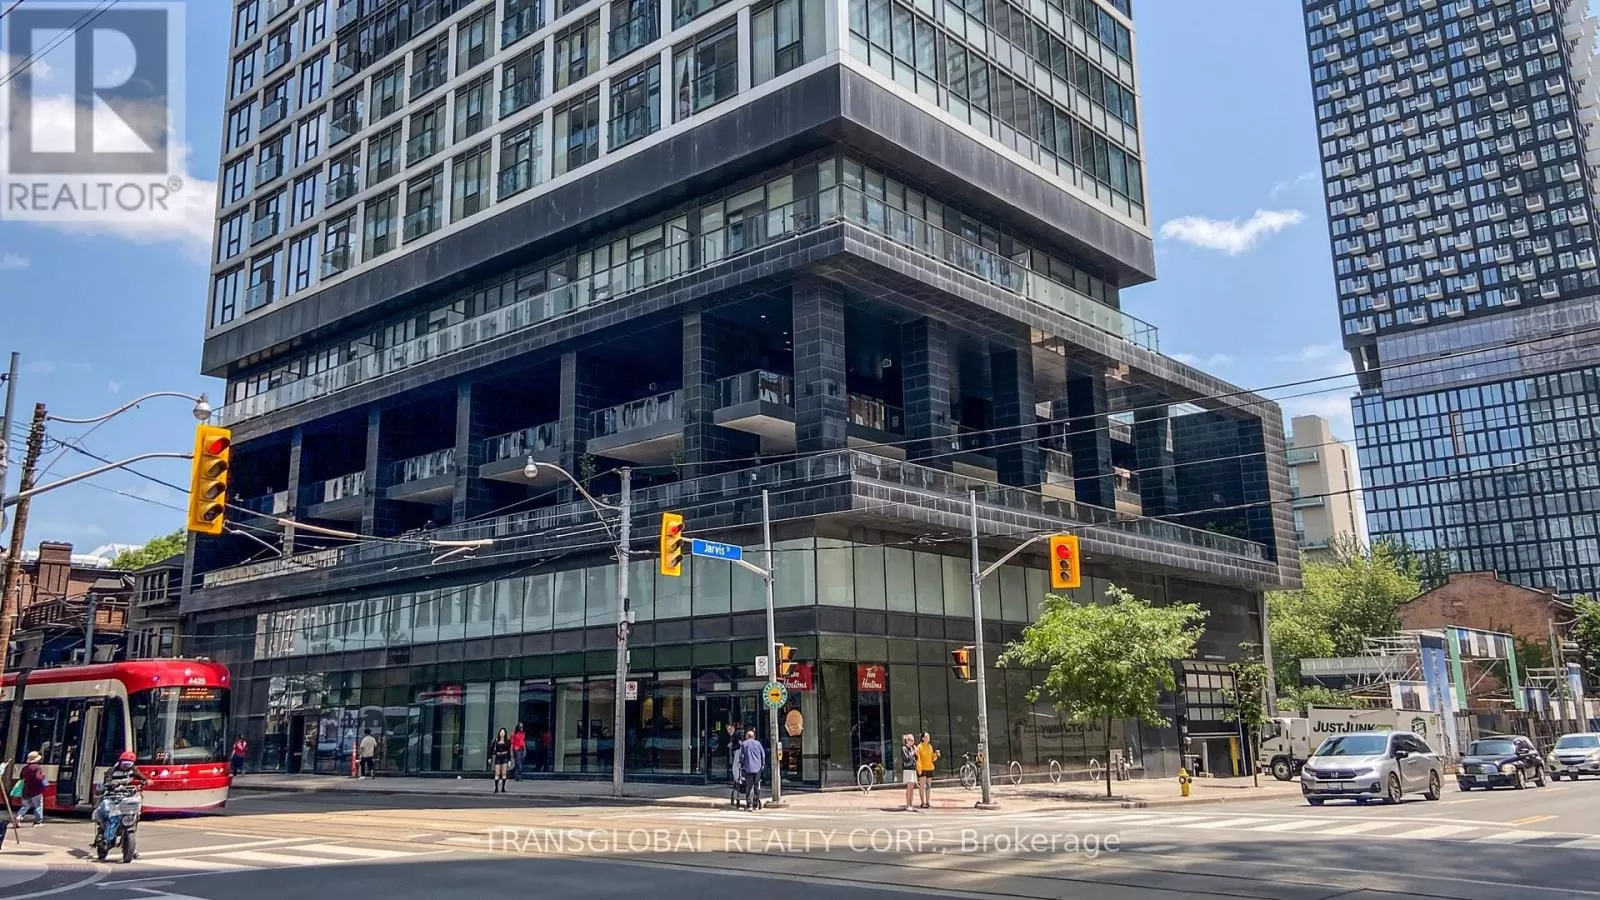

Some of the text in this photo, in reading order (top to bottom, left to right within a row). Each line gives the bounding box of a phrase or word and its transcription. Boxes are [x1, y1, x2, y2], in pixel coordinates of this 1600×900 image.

[704, 543, 725, 556] Jarvis
[865, 667, 877, 678] Tim
[783, 679, 808, 689] Hortons
[862, 678, 882, 689] Hortons
